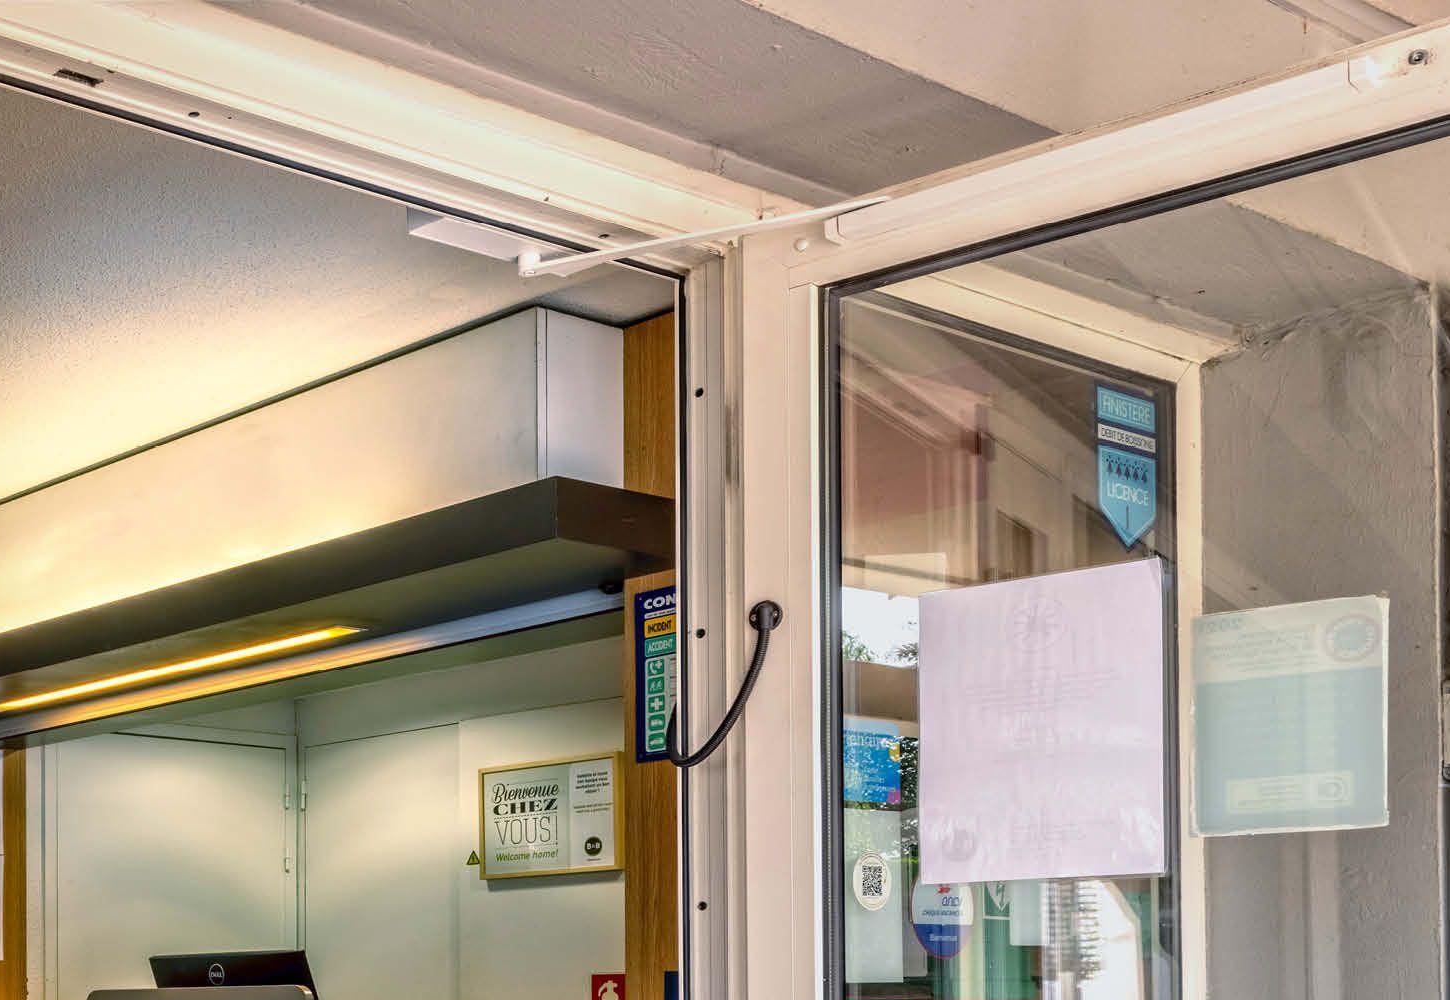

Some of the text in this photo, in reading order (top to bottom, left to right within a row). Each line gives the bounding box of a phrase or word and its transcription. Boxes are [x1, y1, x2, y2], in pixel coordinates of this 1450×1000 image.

[1106, 479, 1150, 507] LICENCE
[647, 620, 672, 634] INCIDENT
[647, 638, 674, 653] ACCIDENT
[493, 783, 559, 804] Bienvenue
[493, 798, 558, 816] CHEZ
[496, 852, 531, 862] Welcome
